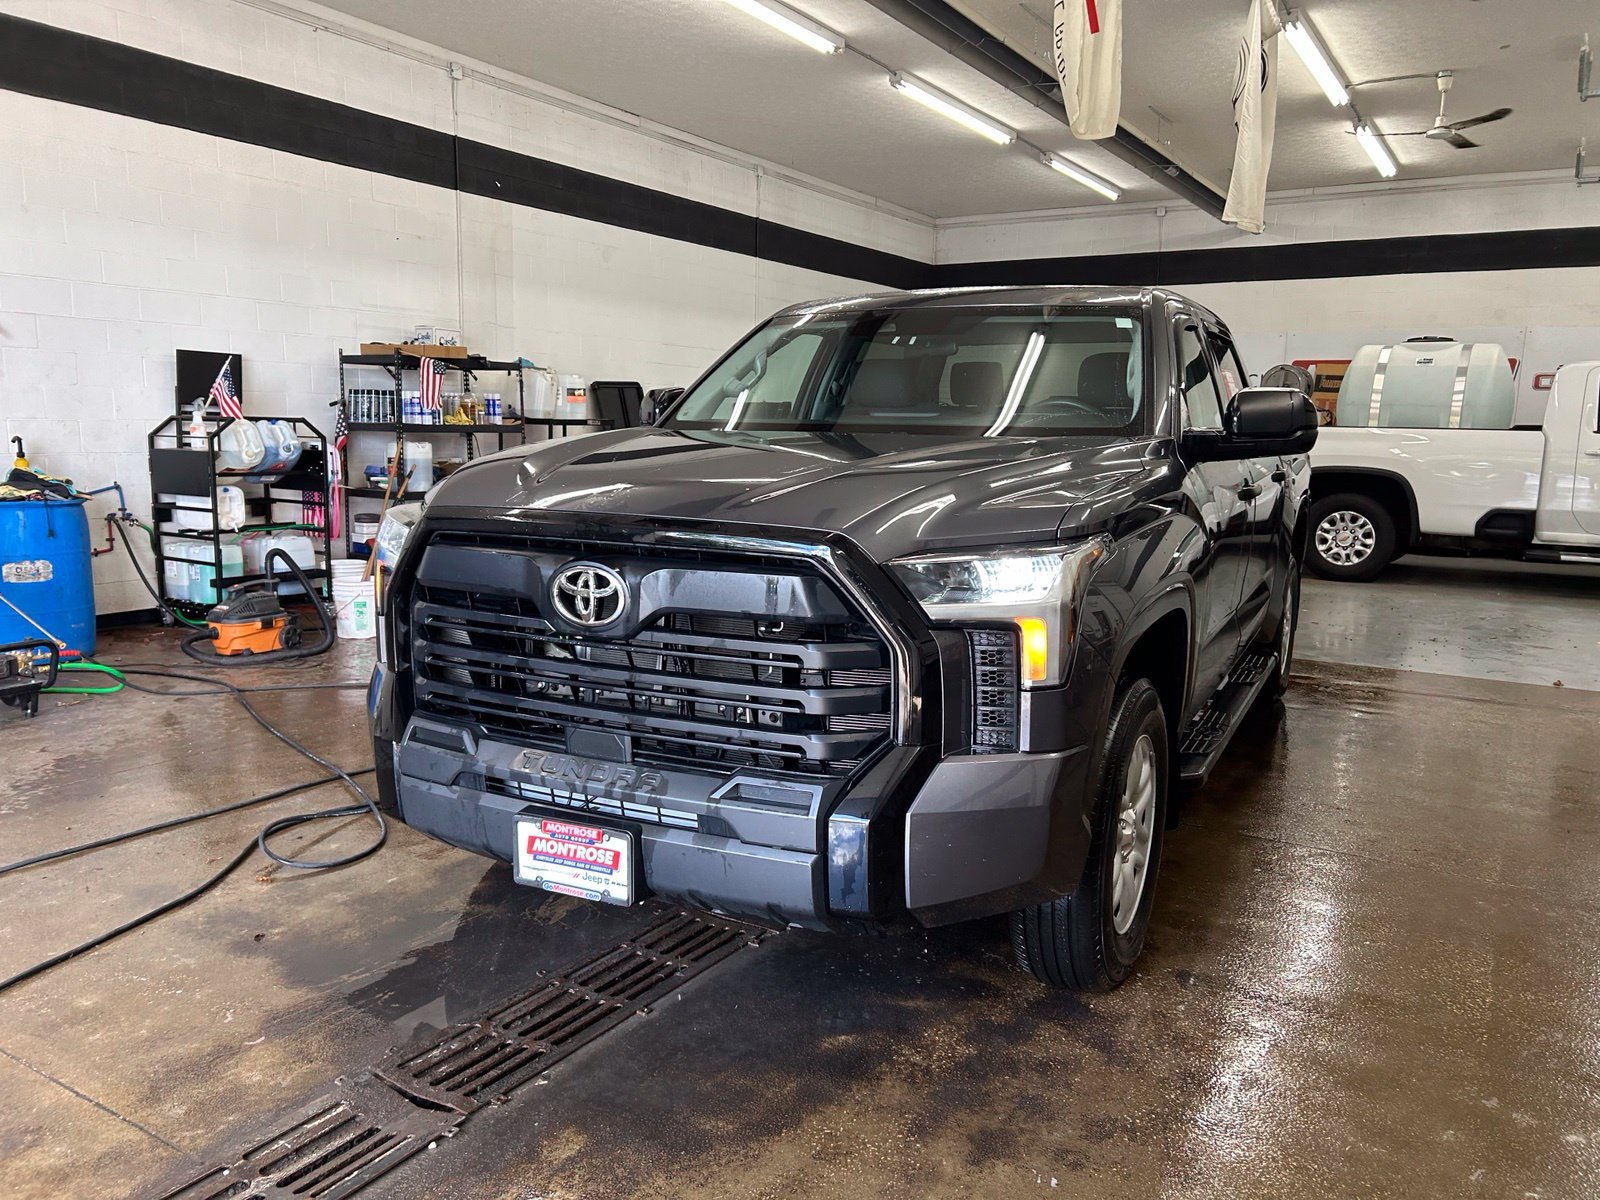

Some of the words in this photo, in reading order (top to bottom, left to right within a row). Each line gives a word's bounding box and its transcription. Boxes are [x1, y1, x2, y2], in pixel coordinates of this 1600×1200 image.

[523, 751, 665, 791] TUNDRA
[546, 823, 598, 839] MONTROSE
[532, 838, 614, 865] MONTROSE
[535, 855, 554, 863] CHRYSLER
[582, 872, 603, 885] Jeep
